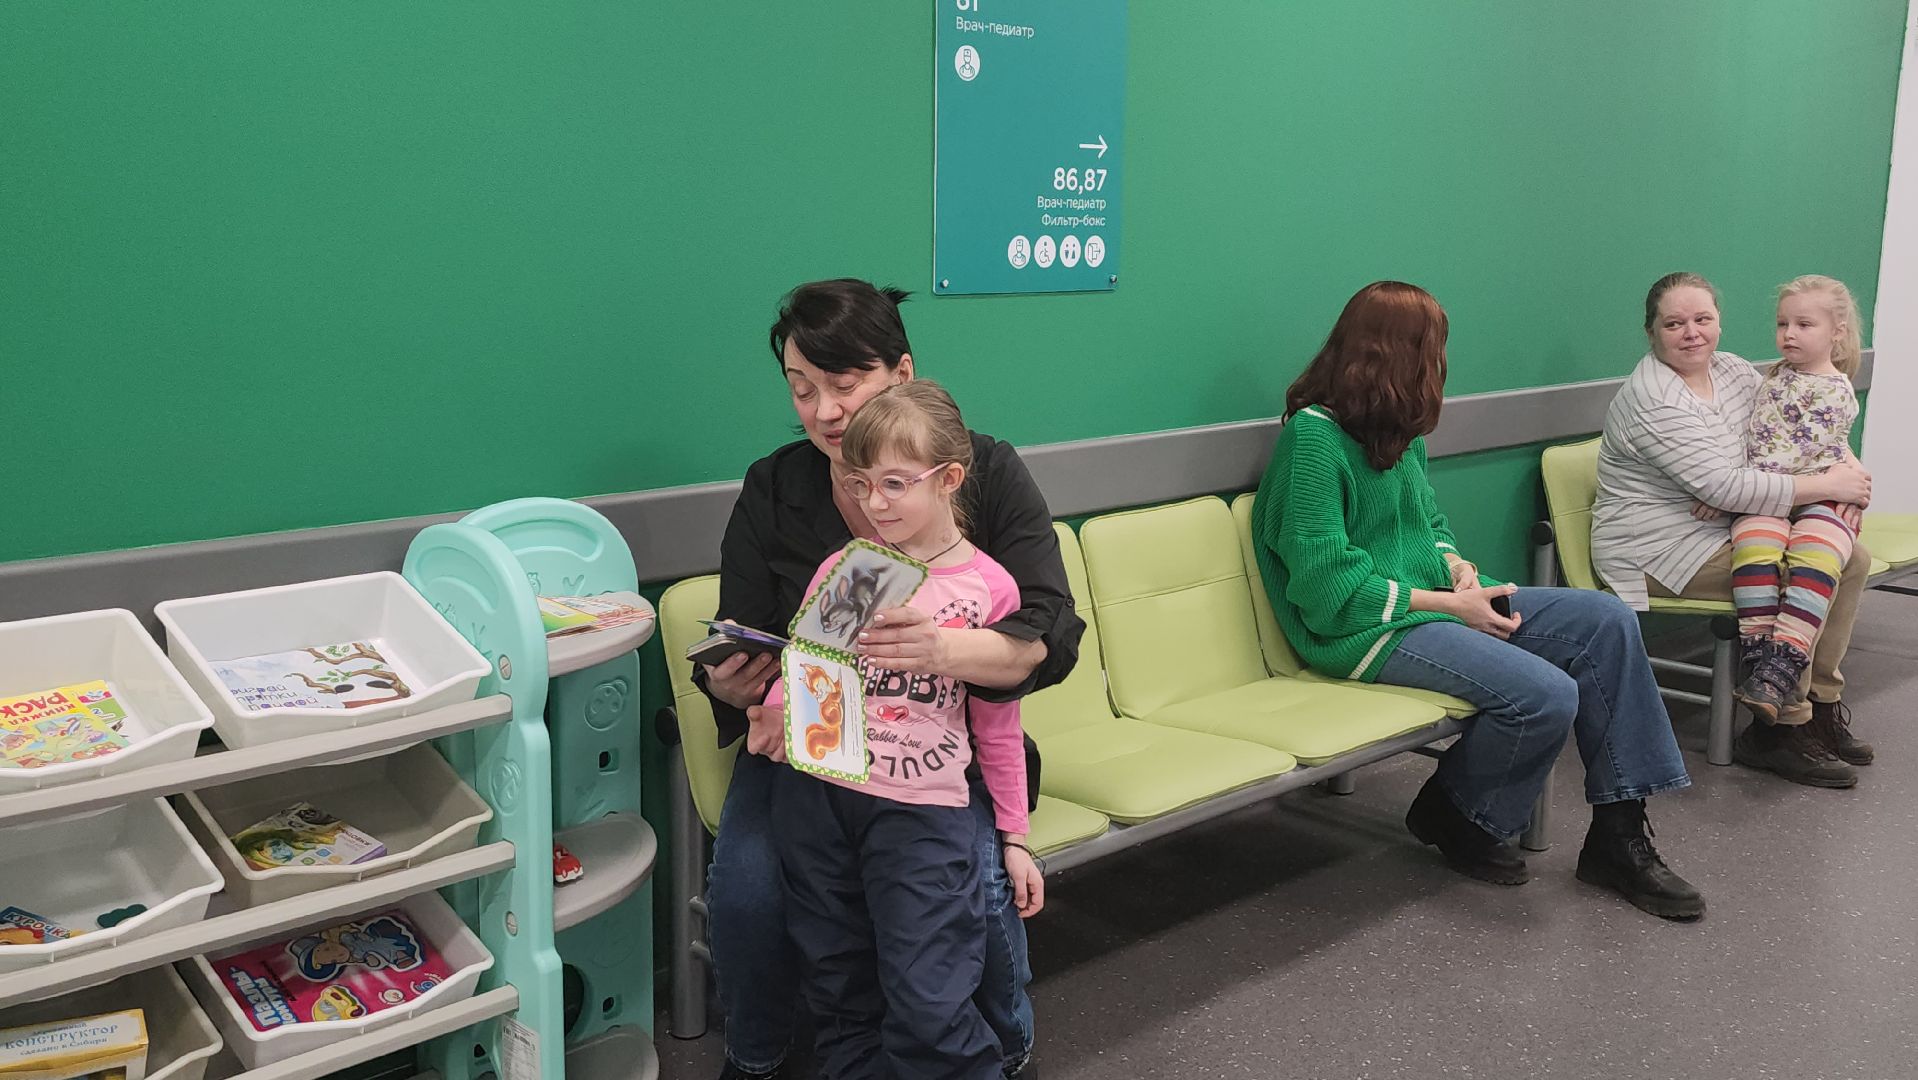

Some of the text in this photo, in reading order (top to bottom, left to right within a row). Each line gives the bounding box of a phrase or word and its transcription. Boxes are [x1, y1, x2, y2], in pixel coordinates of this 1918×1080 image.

[956, 16, 1035, 39] Врач-педиатр
[1053, 167, 1107, 194] 86,87
[1037, 196, 1107, 211] Врач-педиатр
[1041, 213, 1106, 228] Фильтр-бокс
[899, 733, 922, 750] Love
[5, 1024, 119, 1050] КОНСТРУКТОР
